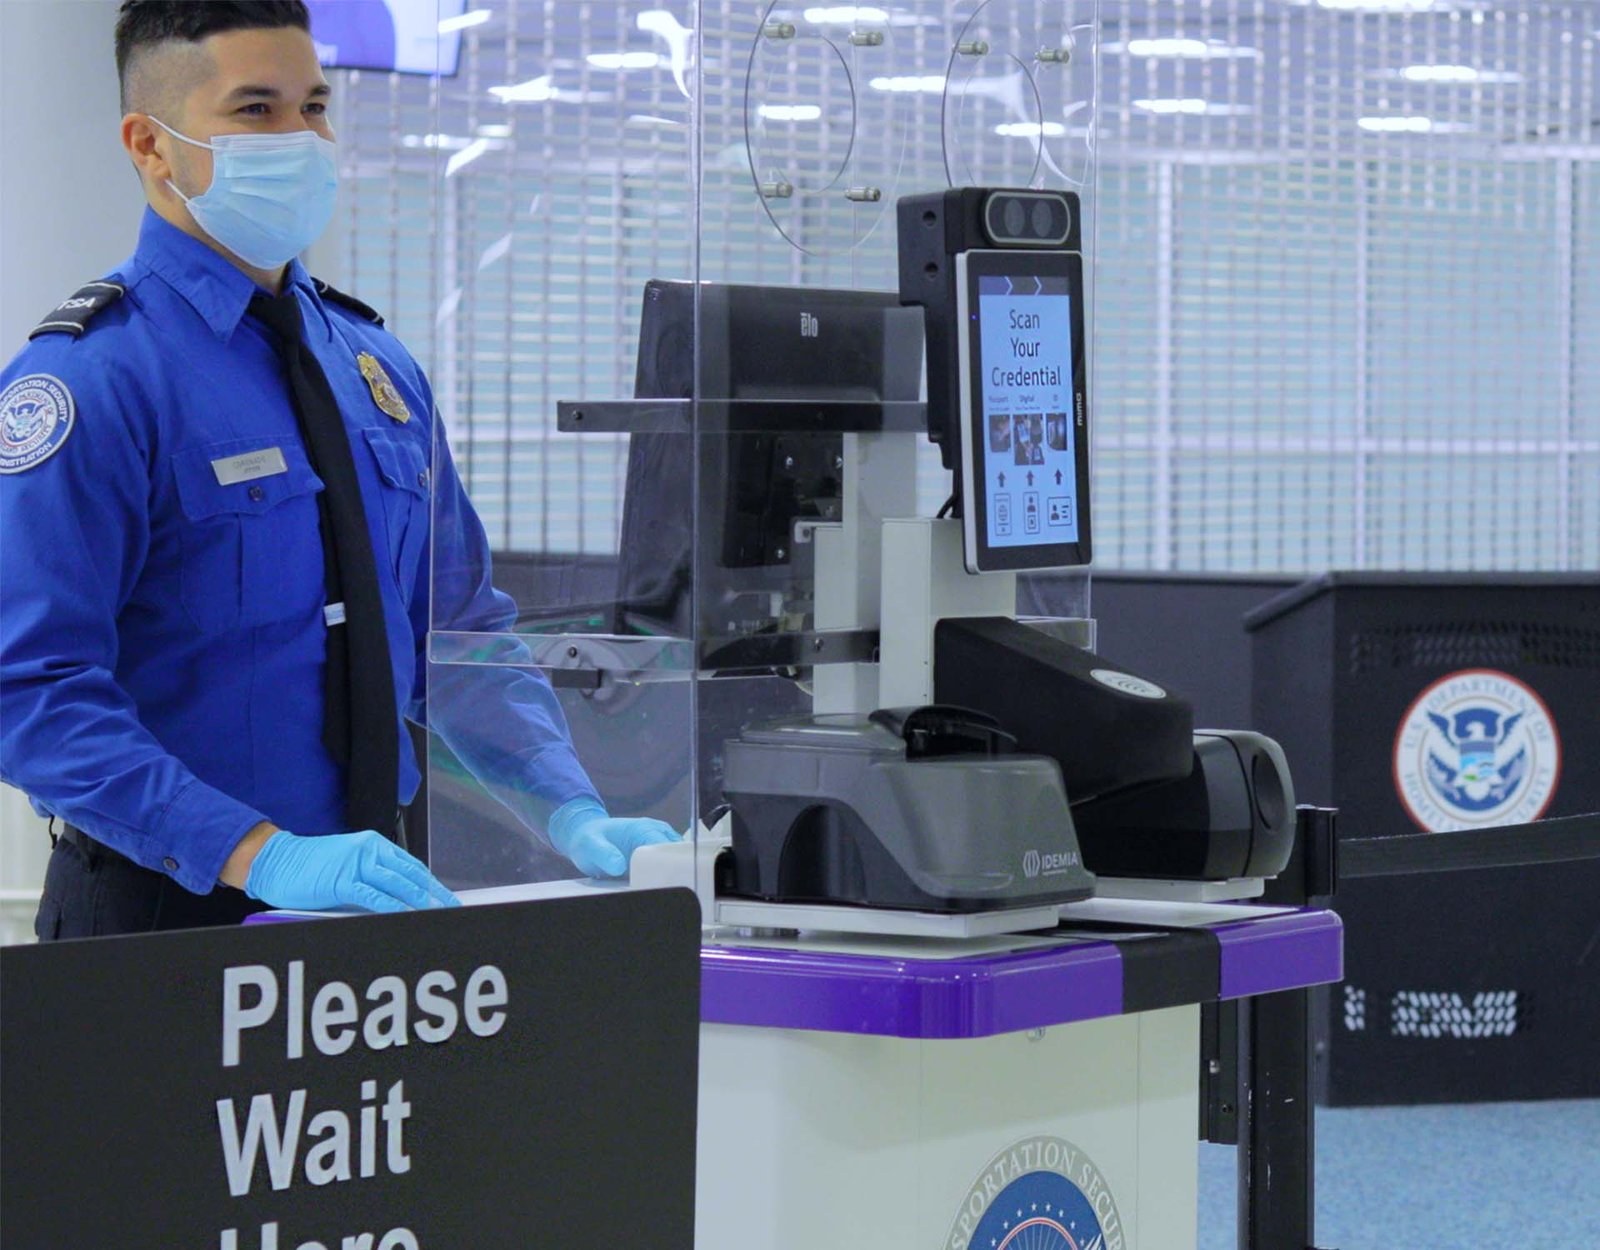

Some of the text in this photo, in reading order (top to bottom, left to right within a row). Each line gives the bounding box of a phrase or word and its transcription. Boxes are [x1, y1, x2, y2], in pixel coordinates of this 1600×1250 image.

[57, 297, 96, 311] TSA
[1009, 309, 1040, 329] Scan
[1010, 337, 1041, 358] Your
[991, 366, 1062, 386] Credential
[1075, 392, 1083, 427] mimo
[1041, 852, 1079, 870] IDEMIA
[222, 960, 509, 1067] Please
[216, 1079, 411, 1197] Wait
